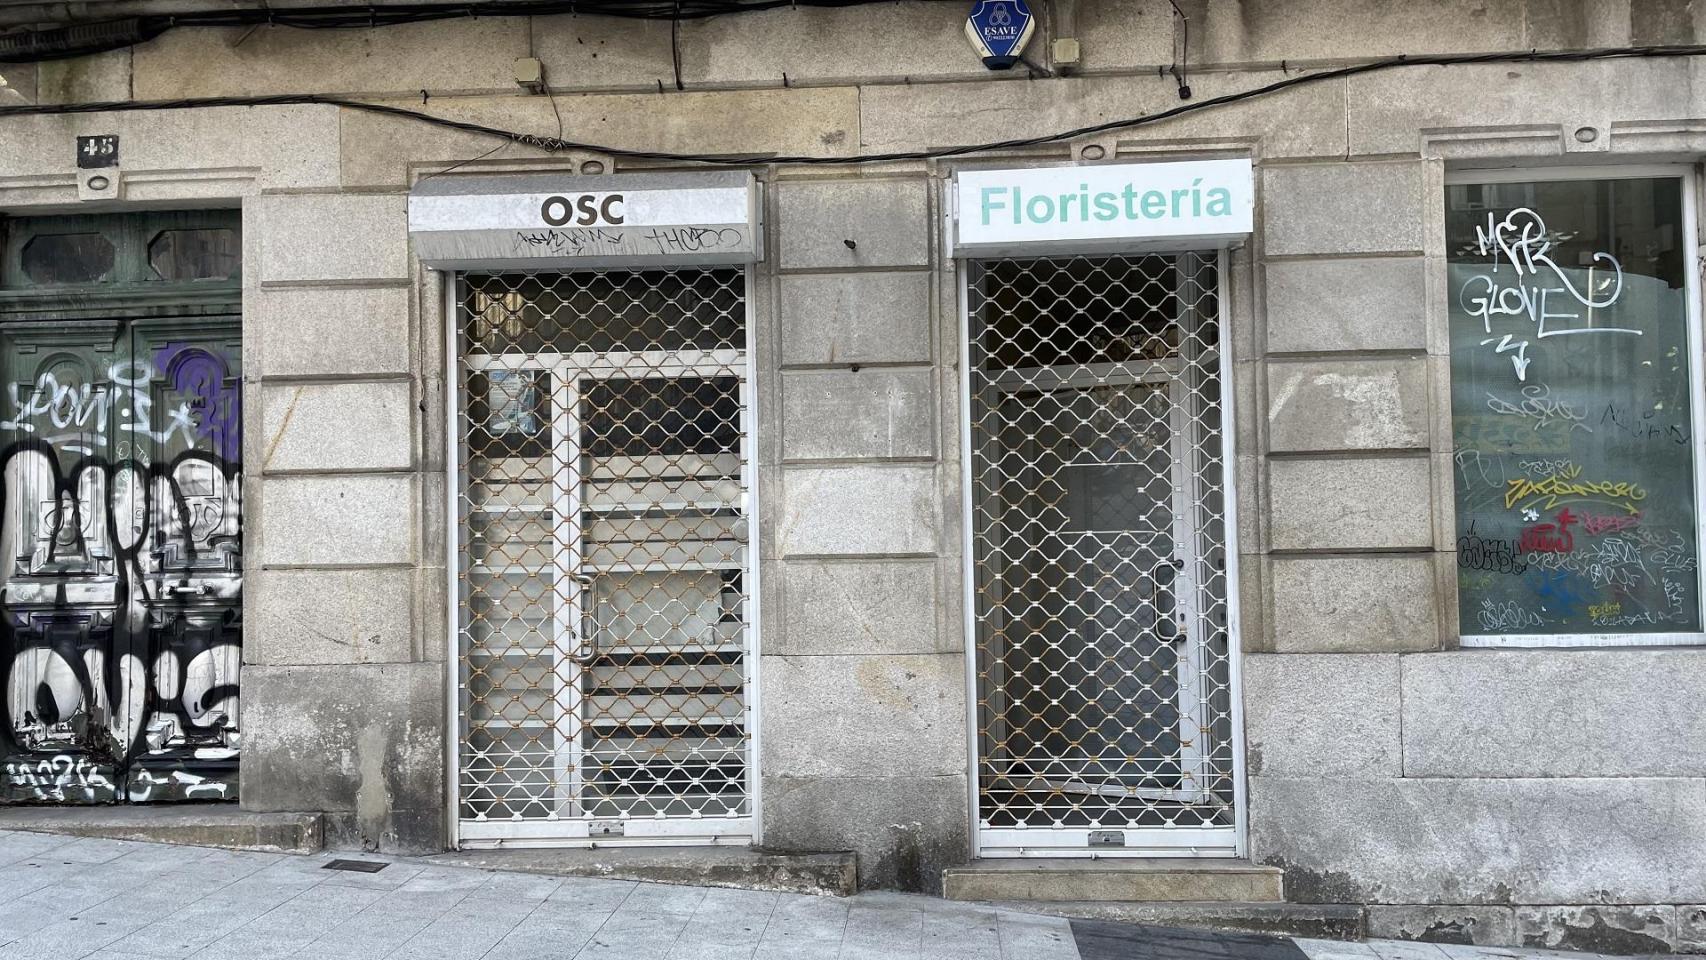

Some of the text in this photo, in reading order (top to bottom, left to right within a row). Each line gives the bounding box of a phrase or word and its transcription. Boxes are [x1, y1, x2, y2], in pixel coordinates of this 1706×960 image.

[984, 26, 1018, 36] ESAVE
[541, 194, 624, 227] OSC
[981, 177, 1232, 226] Floristería
[1459, 275, 1643, 339] GLOVE
